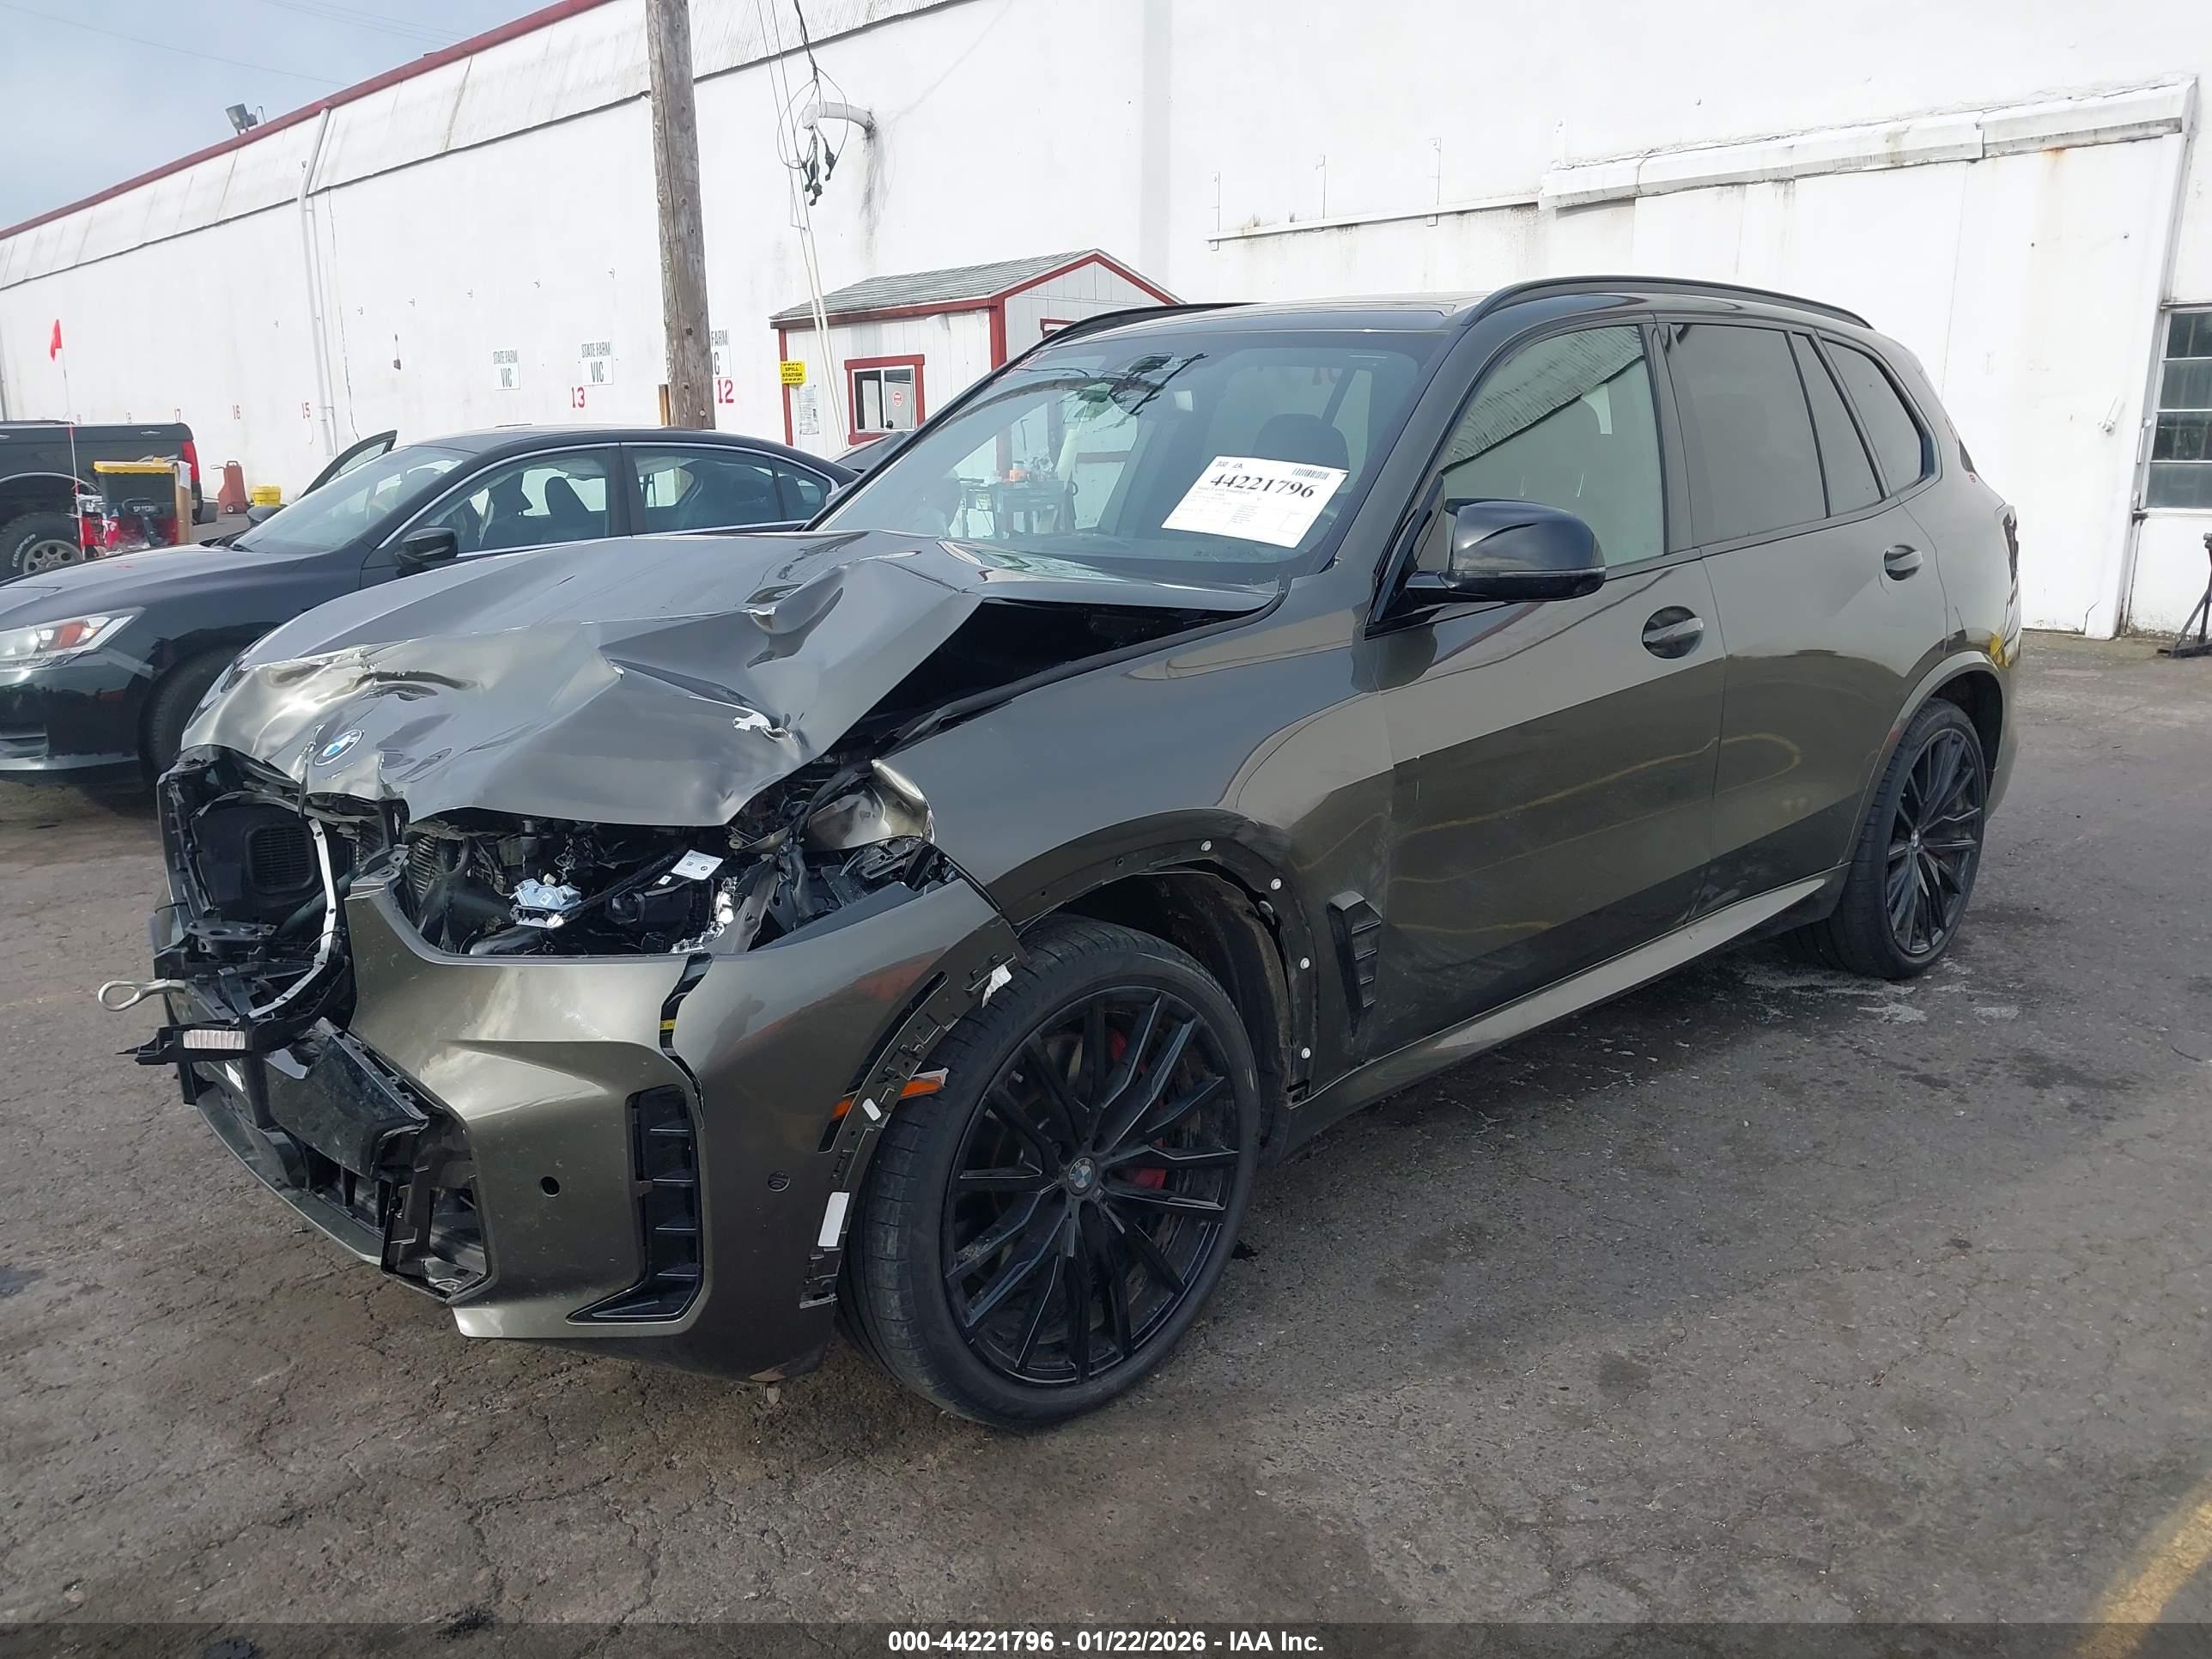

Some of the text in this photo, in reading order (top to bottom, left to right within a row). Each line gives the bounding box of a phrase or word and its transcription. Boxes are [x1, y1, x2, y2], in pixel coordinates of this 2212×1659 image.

[493, 349, 518, 365] STATE FARM
[581, 341, 611, 358] STATE FARM
[501, 368, 513, 388] VIC
[590, 361, 605, 383] VIC
[571, 386, 586, 409] 13
[717, 379, 734, 404] 12
[232, 404, 240, 420] 16
[301, 402, 311, 420] 15
[1210, 473, 1320, 499] 44221796
[12, 533, 36, 568] COOPER
